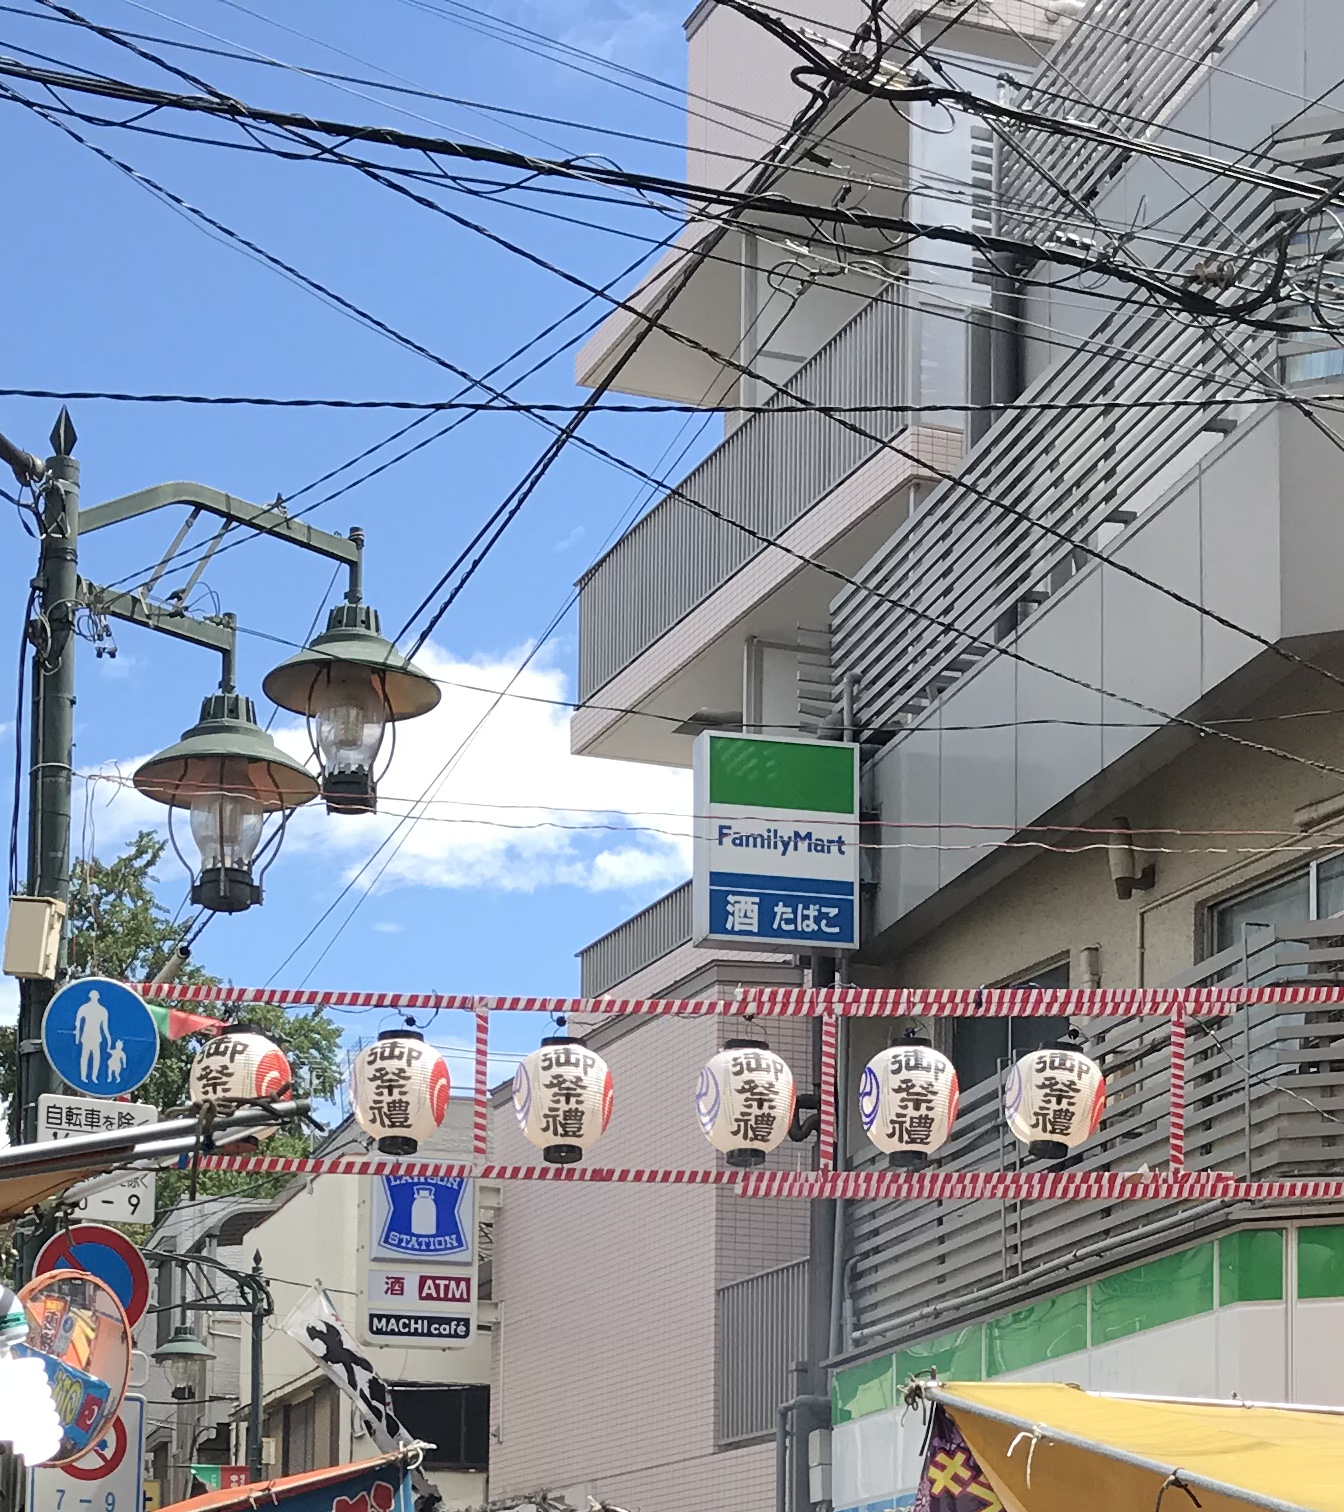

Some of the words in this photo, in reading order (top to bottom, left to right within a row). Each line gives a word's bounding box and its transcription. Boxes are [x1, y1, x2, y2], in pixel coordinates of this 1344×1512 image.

[717, 824, 846, 856] FamilyMart
[725, 894, 760, 933] 酒
[772, 901, 840, 934] たばこ
[196, 1036, 249, 1097] 御祭
[366, 1041, 423, 1130] 御祭禮
[541, 1042, 596, 1138] 御祭禮
[730, 1050, 785, 1143] 御祭禮
[885, 1048, 946, 1146] 御祭禮
[1031, 1049, 1097, 1137] 御祭禮
[388, 1231, 459, 1250] STATION
[384, 1276, 406, 1296] 酒
[421, 1279, 468, 1300] ATM
[372, 1316, 428, 1334] MACHI
[430, 1321, 467, 1336] café
